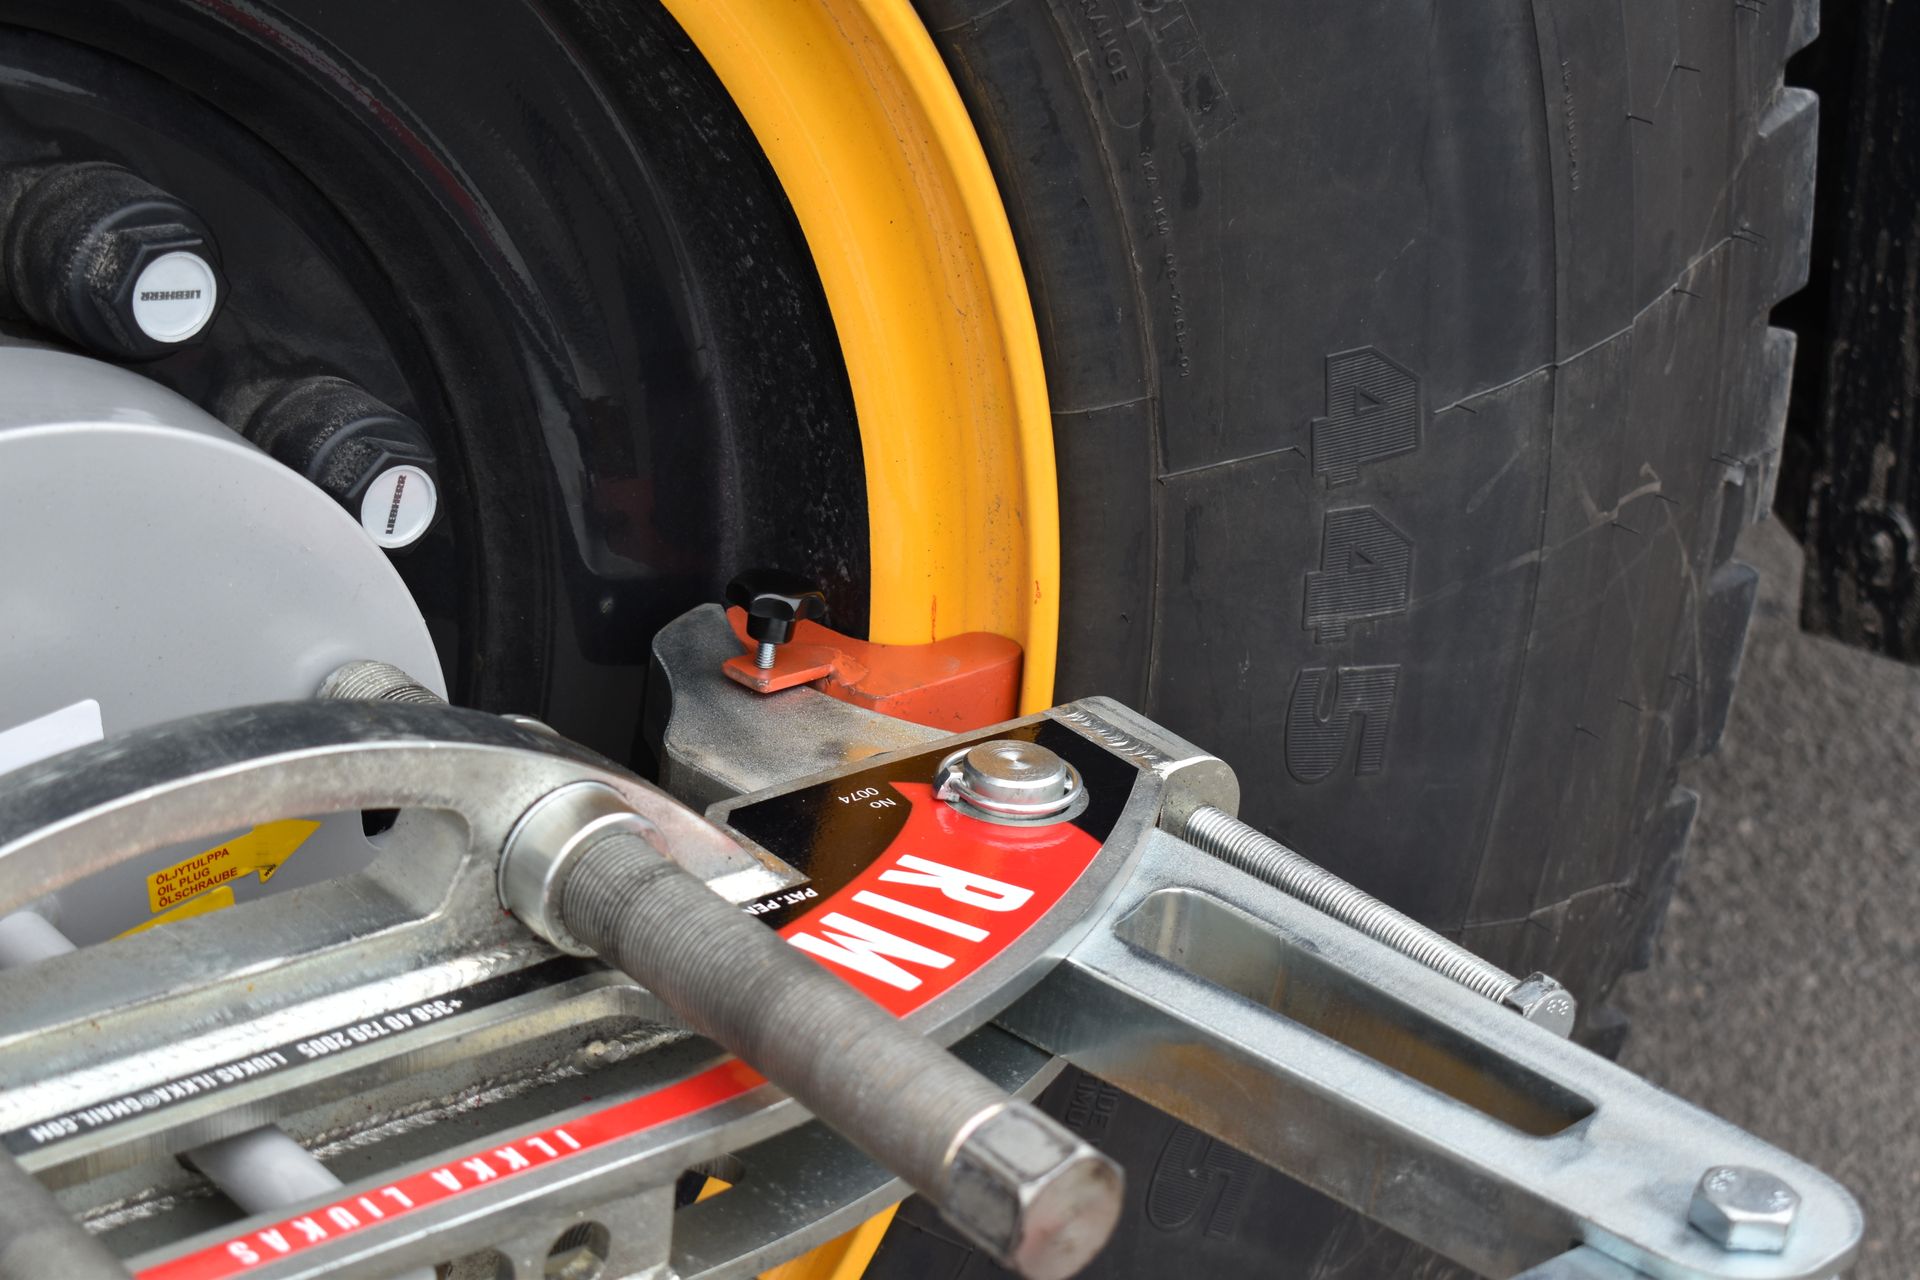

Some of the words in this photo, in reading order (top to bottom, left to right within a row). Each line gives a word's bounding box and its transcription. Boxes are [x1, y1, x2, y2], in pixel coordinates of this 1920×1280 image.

[141, 289, 202, 302] LIEBHERR
[385, 474, 408, 535] LIEBHERR
[1284, 345, 1423, 785] 445
[838, 787, 880, 805] 0074
[869, 797, 897, 809] No
[156, 848, 230, 885] ÖLJYTULPPA
[157, 884, 177, 897] OIL
[179, 867, 211, 887] PLUG
[158, 867, 238, 907] ÖLSCHRAUBE
[788, 854, 1035, 992] RIM
[382, 1013, 414, 1031] 40
[410, 999, 463, 1023] +358
[295, 1032, 353, 1059] 2005
[346, 1020, 392, 1043] 739
[28, 1051, 288, 1144] LIUKAS.ILKKA@GMAIL.COM
[430, 1128, 582, 1192] ILKKA
[226, 1185, 415, 1266] LIUKAS
